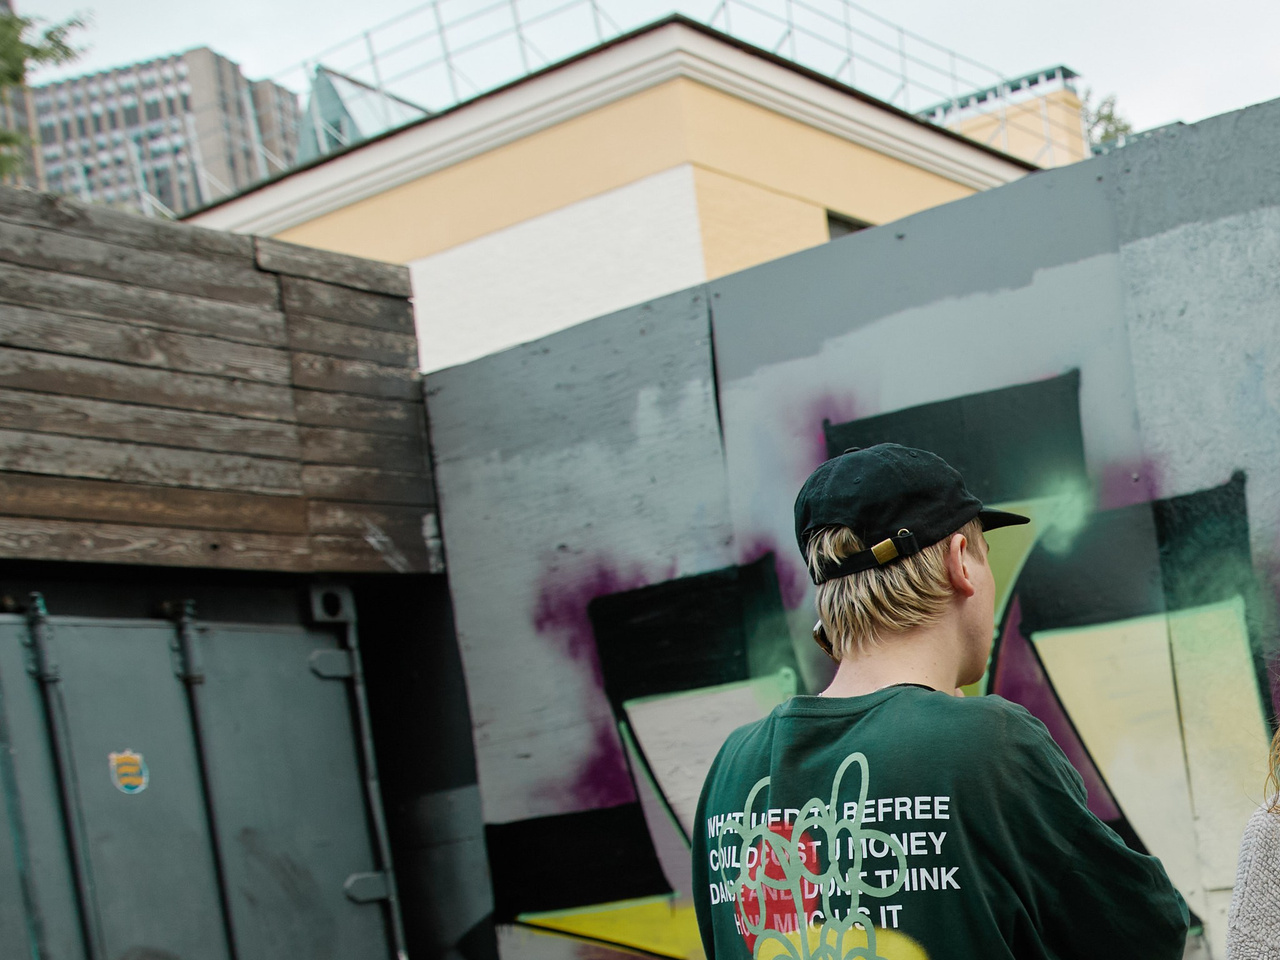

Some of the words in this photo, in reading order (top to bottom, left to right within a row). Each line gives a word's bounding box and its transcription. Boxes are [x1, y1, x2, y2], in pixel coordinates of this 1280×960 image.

[707, 812, 745, 838] WHAT
[709, 845, 758, 871] COULD
[848, 831, 947, 860] MONEY
[875, 866, 961, 892] THINK
[879, 905, 903, 929] IT
